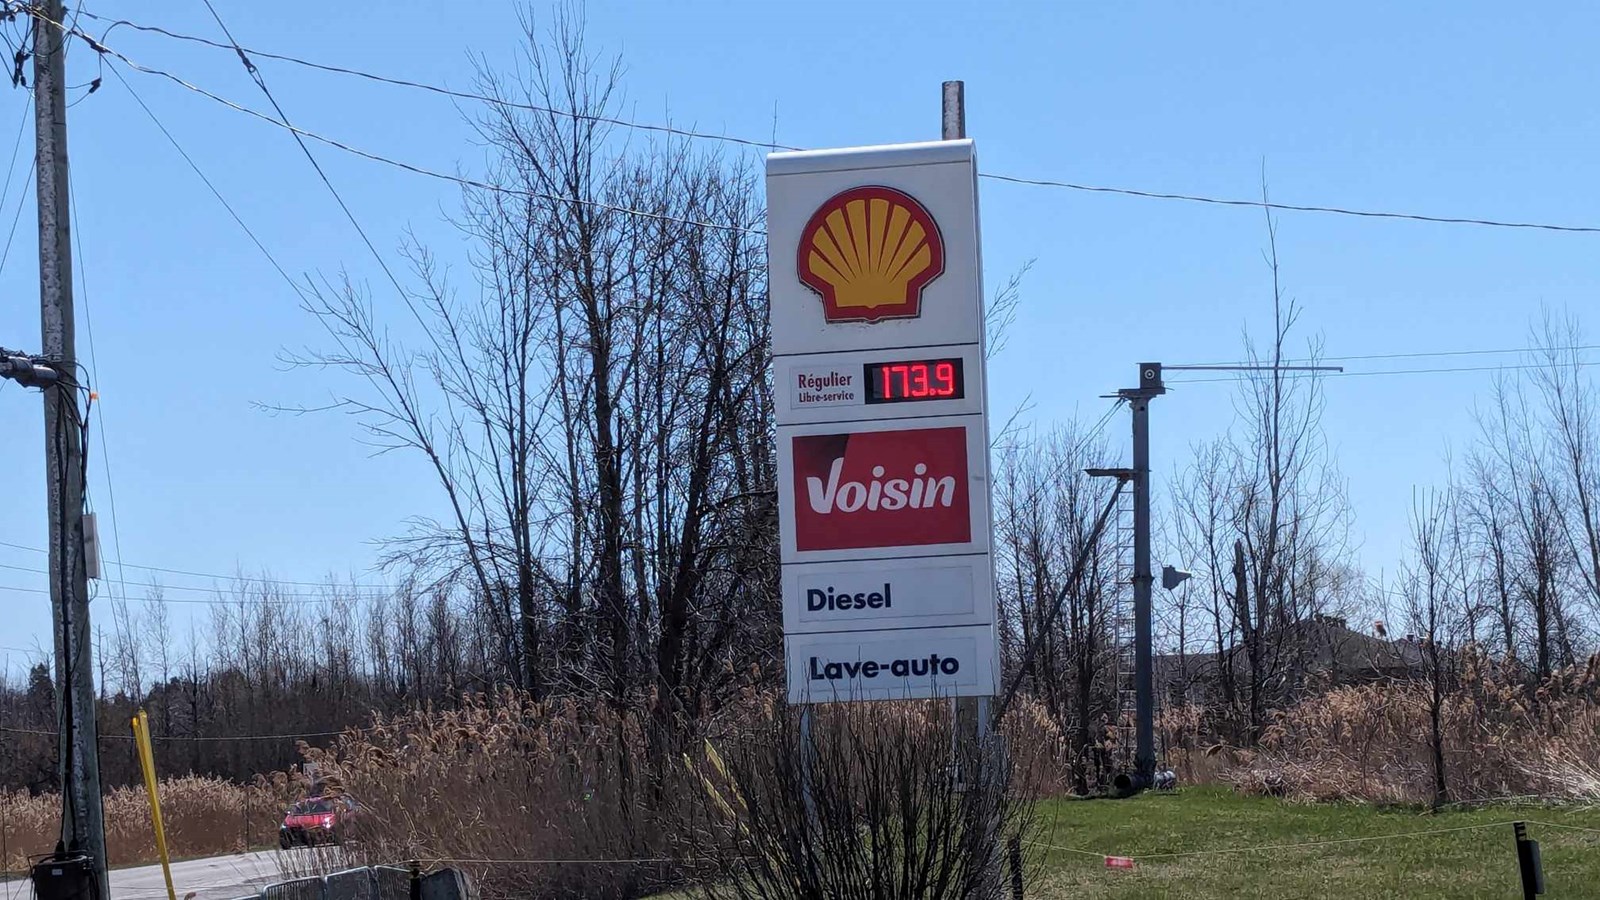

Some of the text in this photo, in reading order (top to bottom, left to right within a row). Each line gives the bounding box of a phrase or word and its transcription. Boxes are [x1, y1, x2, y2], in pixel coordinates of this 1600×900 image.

[798, 372, 852, 392] Régulier
[882, 363, 954, 399] 173.9
[798, 390, 854, 403] Libre-service
[806, 457, 956, 514] Voisin
[807, 583, 892, 611] Diesel
[810, 653, 959, 680] Lave-auto
